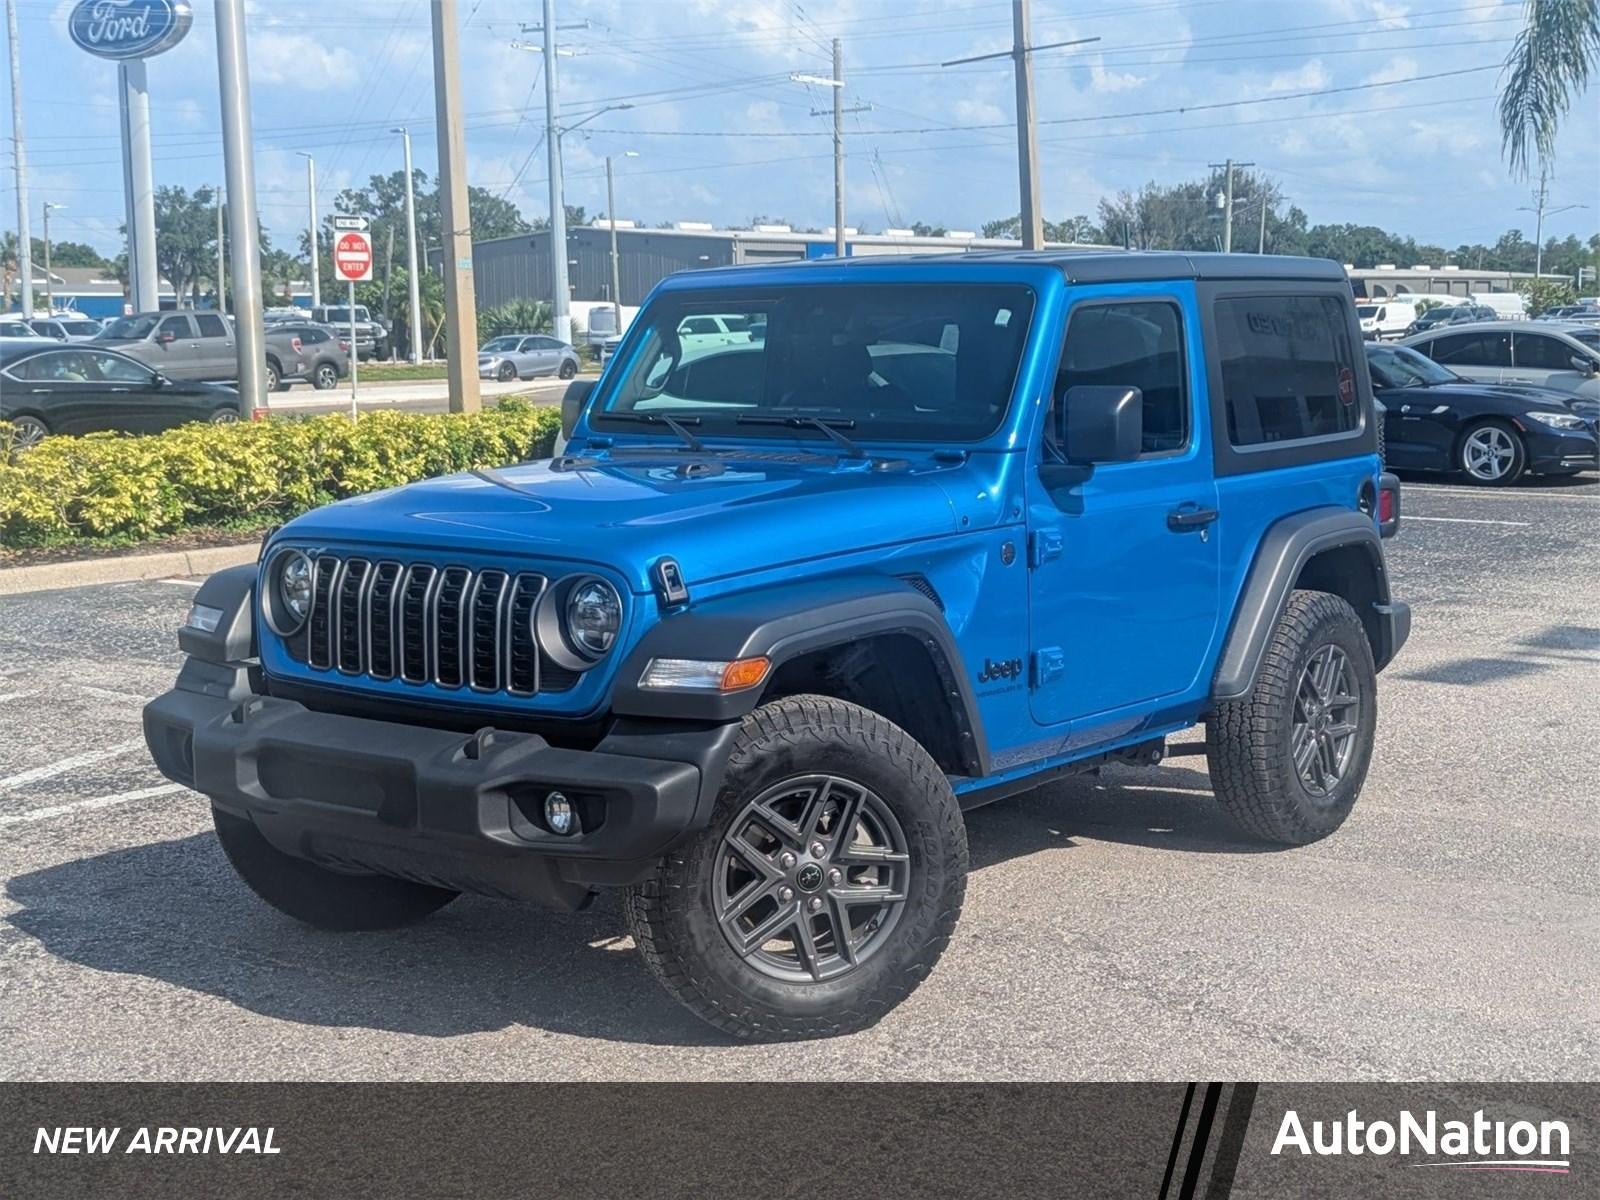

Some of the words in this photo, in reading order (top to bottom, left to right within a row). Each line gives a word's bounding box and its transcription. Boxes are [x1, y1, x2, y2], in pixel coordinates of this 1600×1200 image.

[88, 0, 151, 43] Ford
[340, 241, 350, 250] DO
[352, 241, 366, 250] NOT
[343, 262, 365, 272] ENTER
[977, 657, 1023, 683] Jeep
